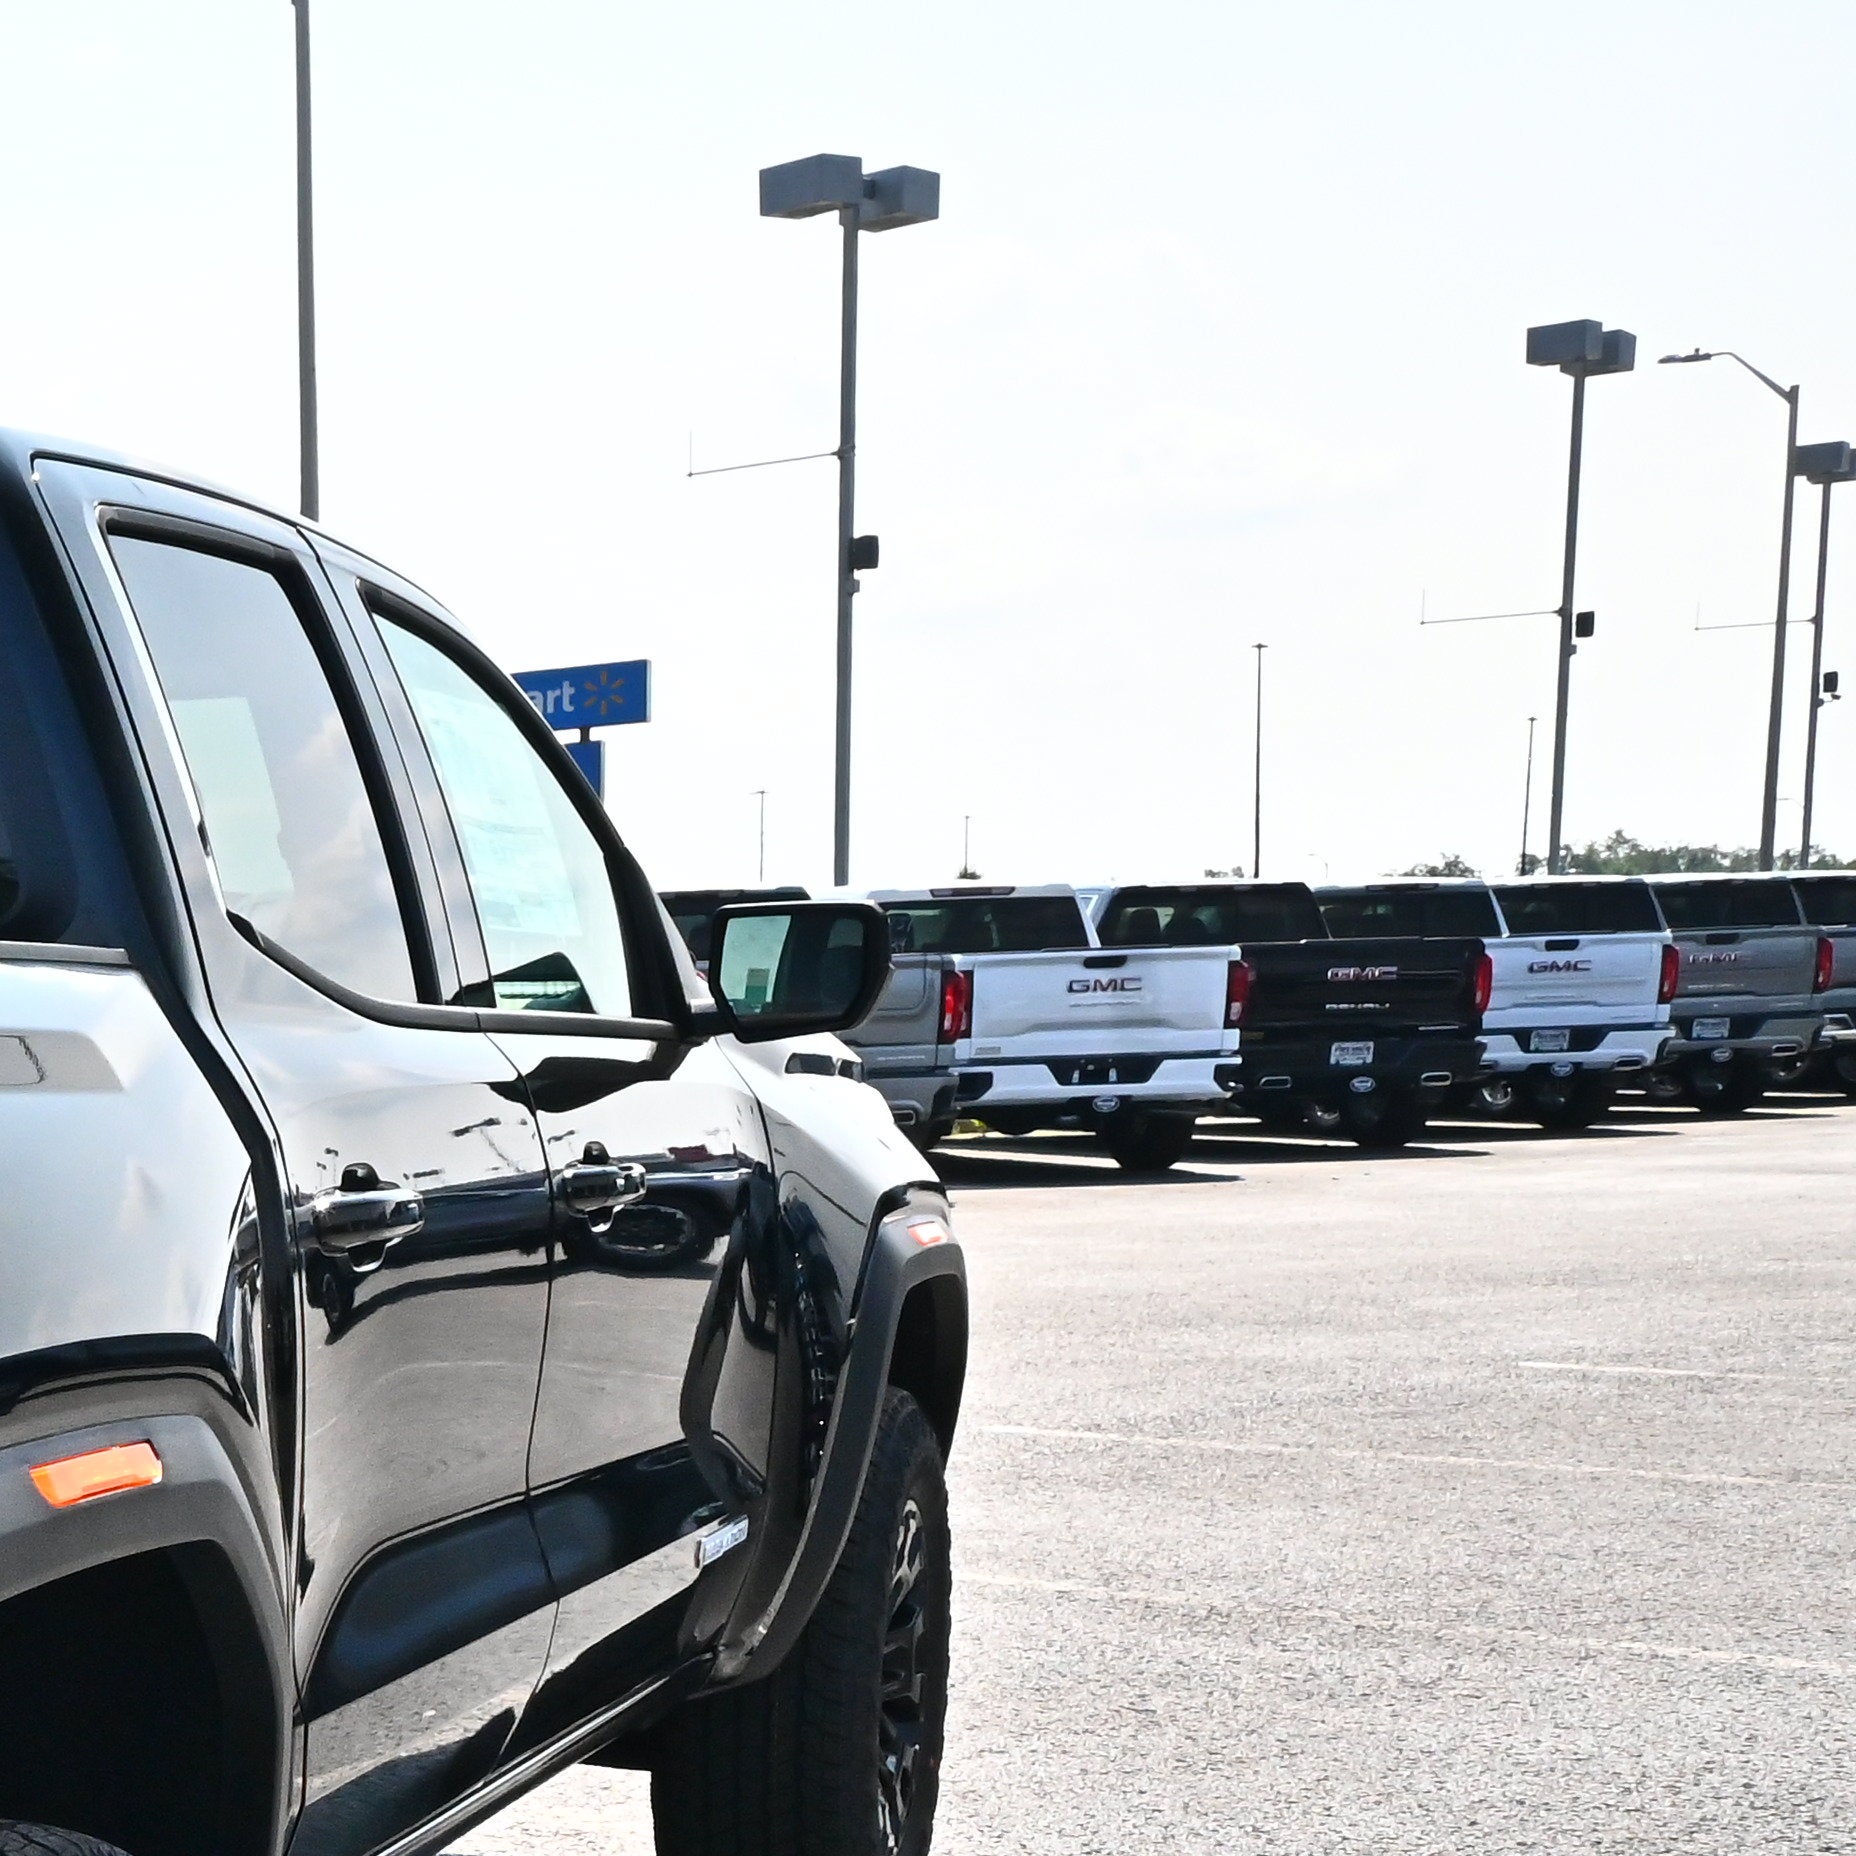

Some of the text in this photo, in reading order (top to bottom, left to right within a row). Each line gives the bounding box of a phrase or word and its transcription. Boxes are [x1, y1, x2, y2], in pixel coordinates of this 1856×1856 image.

[1327, 965, 1398, 981] GMC
[1527, 959, 1592, 973] GMC
[1067, 977, 1143, 993] GMC
